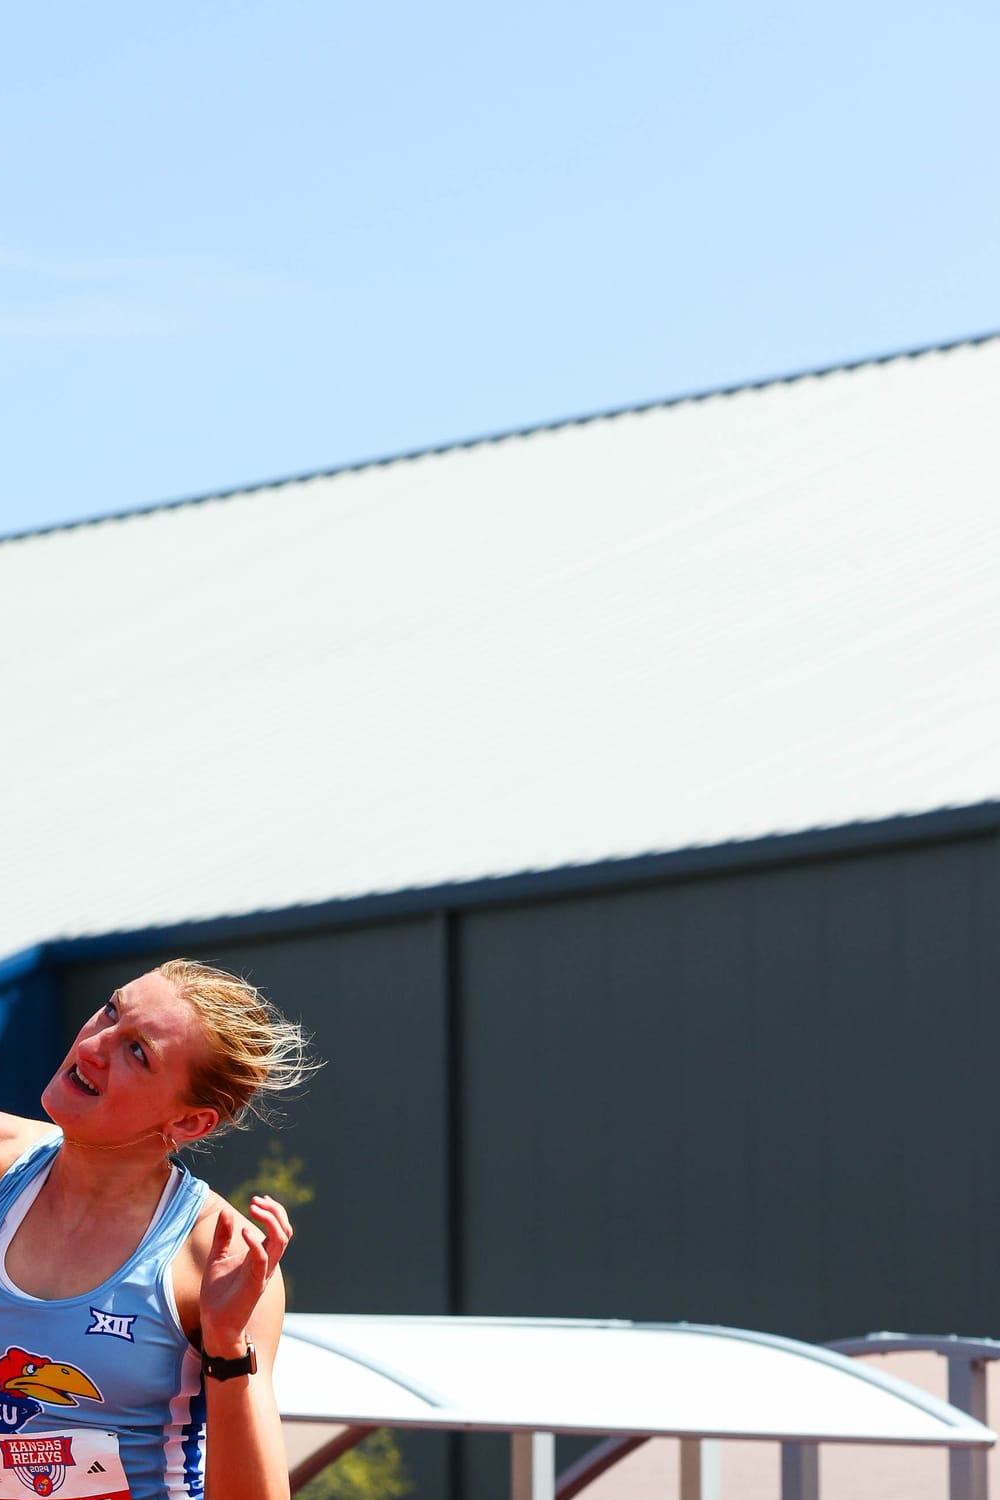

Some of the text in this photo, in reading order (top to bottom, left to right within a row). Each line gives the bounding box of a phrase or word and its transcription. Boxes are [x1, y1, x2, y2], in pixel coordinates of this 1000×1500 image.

[87, 1309, 136, 1342] XII
[9, 1440, 62, 1453] KANSAS
[11, 1451, 62, 1465] RELAYS
[30, 1465, 50, 1473] 2024
